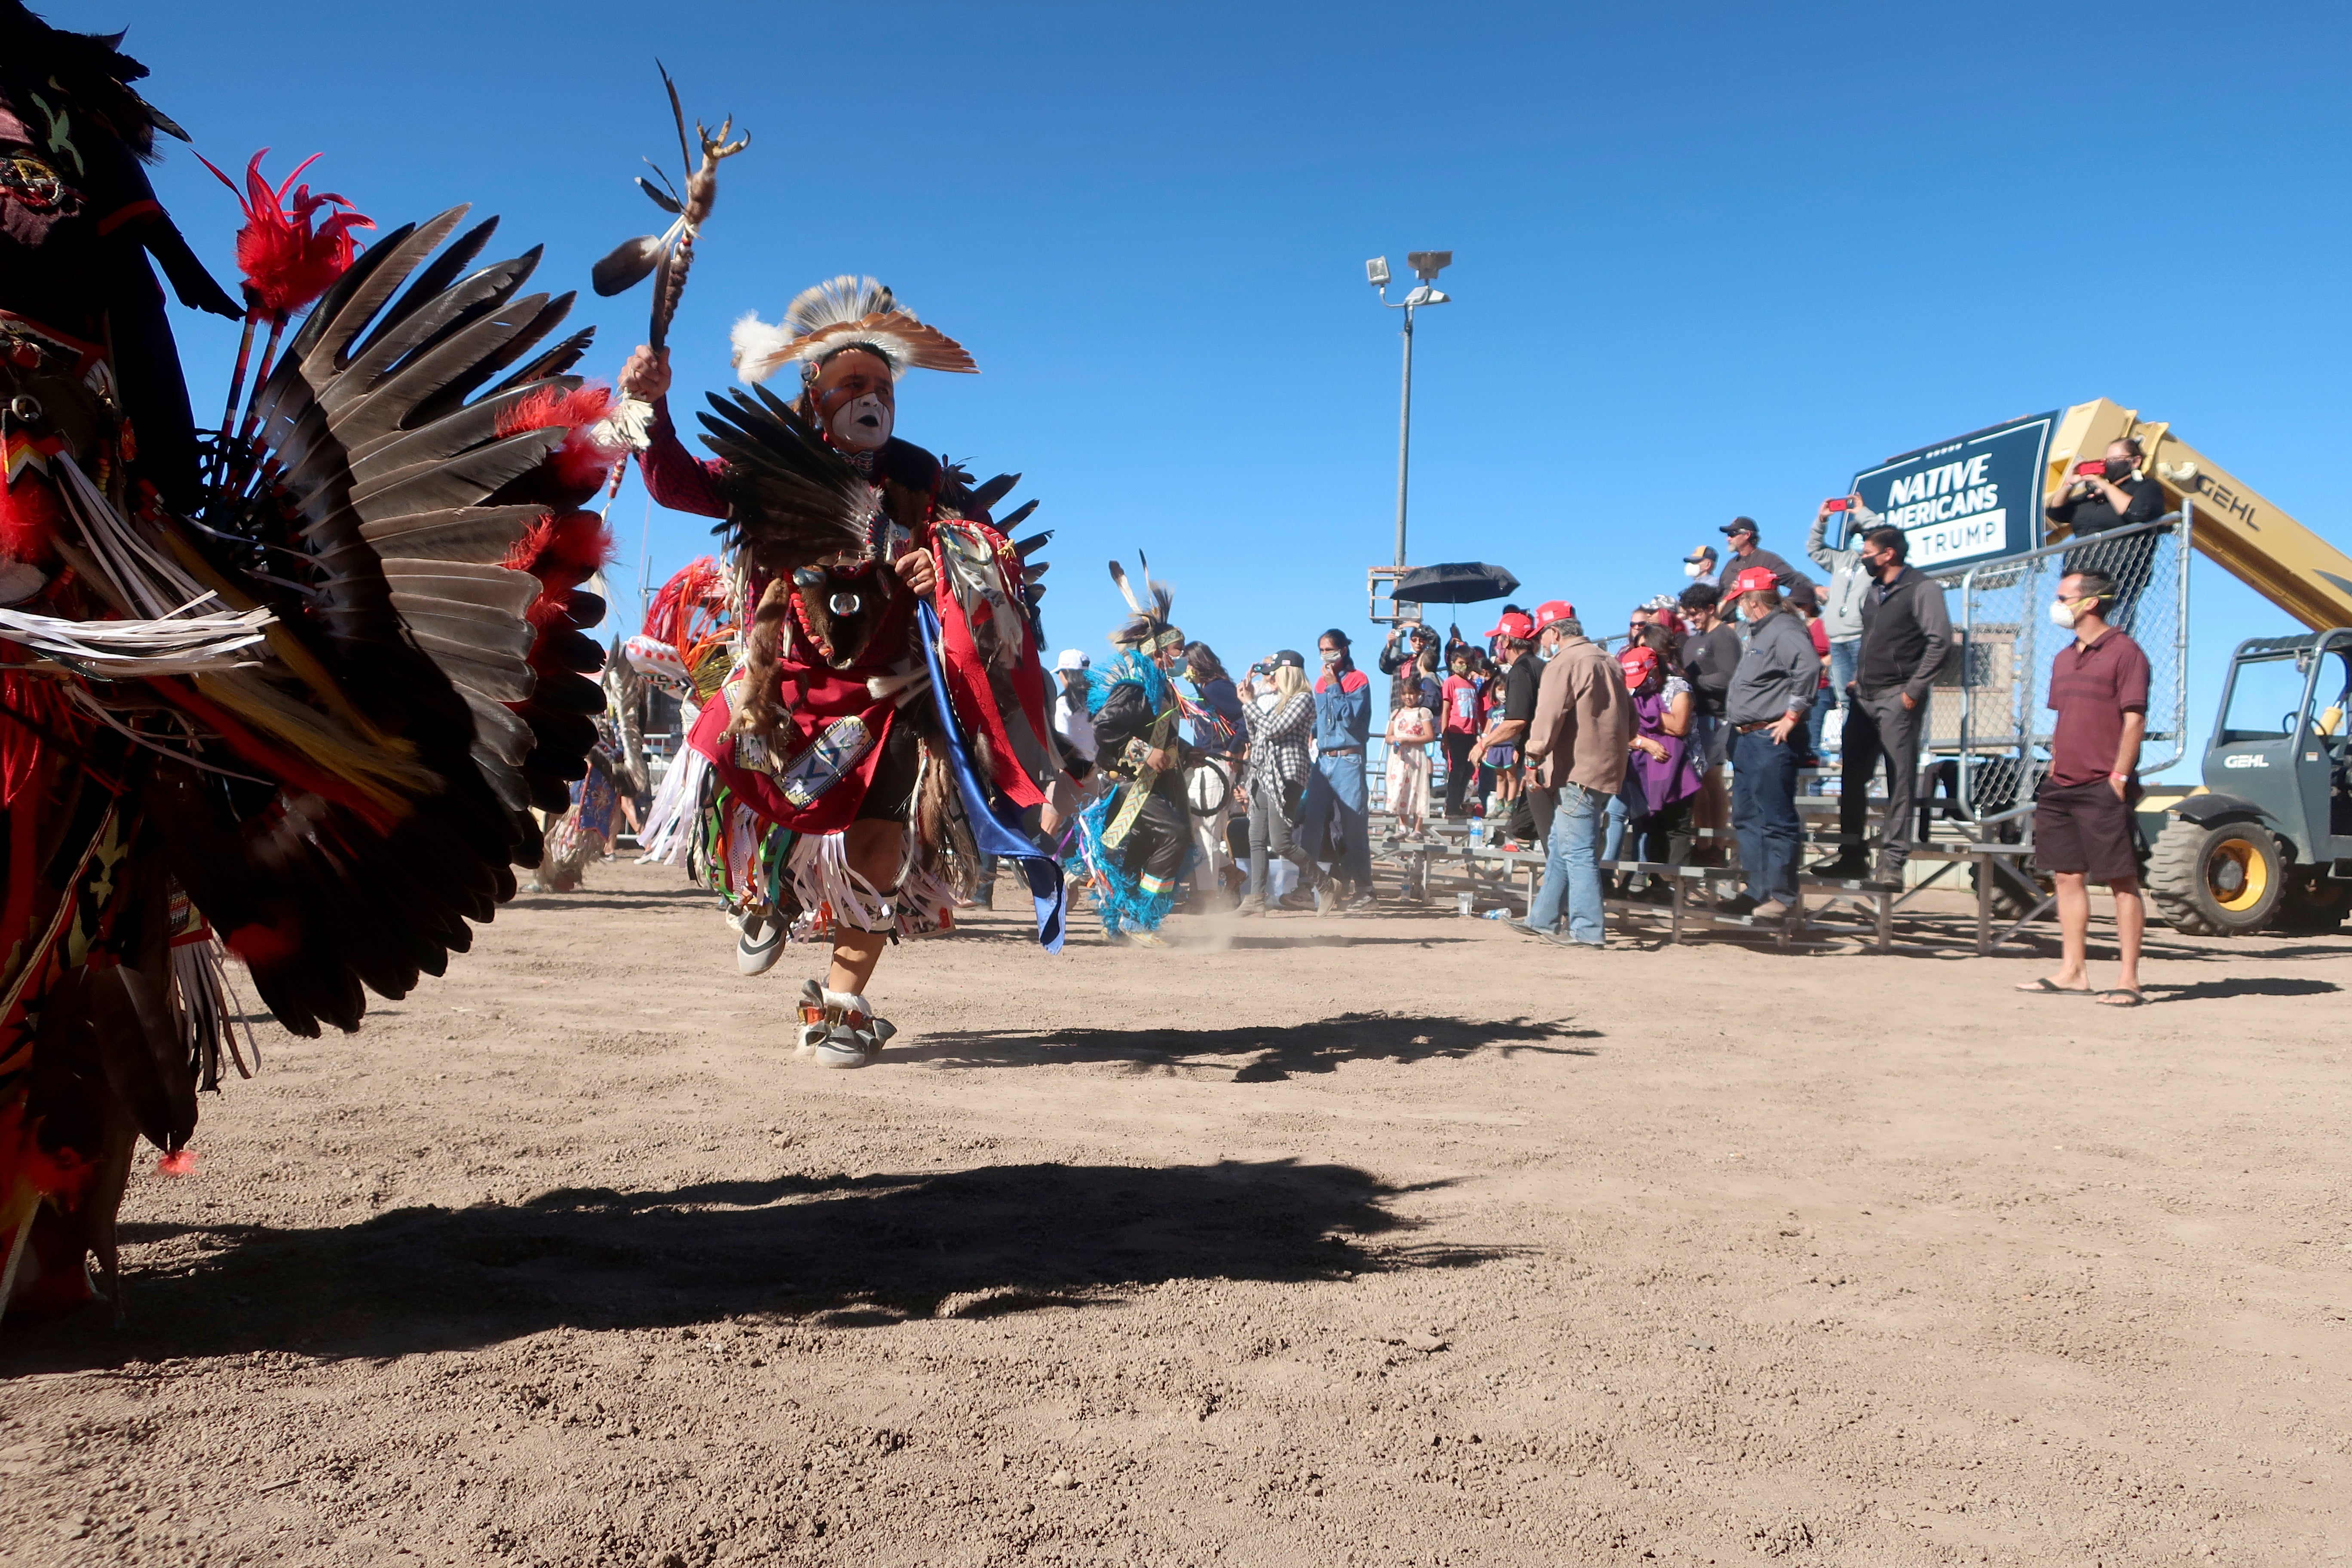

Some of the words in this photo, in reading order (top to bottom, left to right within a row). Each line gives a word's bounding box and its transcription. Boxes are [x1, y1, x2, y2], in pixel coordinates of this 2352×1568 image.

[1887, 453, 1992, 508] NATIVE
[2196, 474, 2261, 531] GEHL
[1922, 521, 1996, 555] TRUMP
[2224, 754, 2269, 769] GEHL
